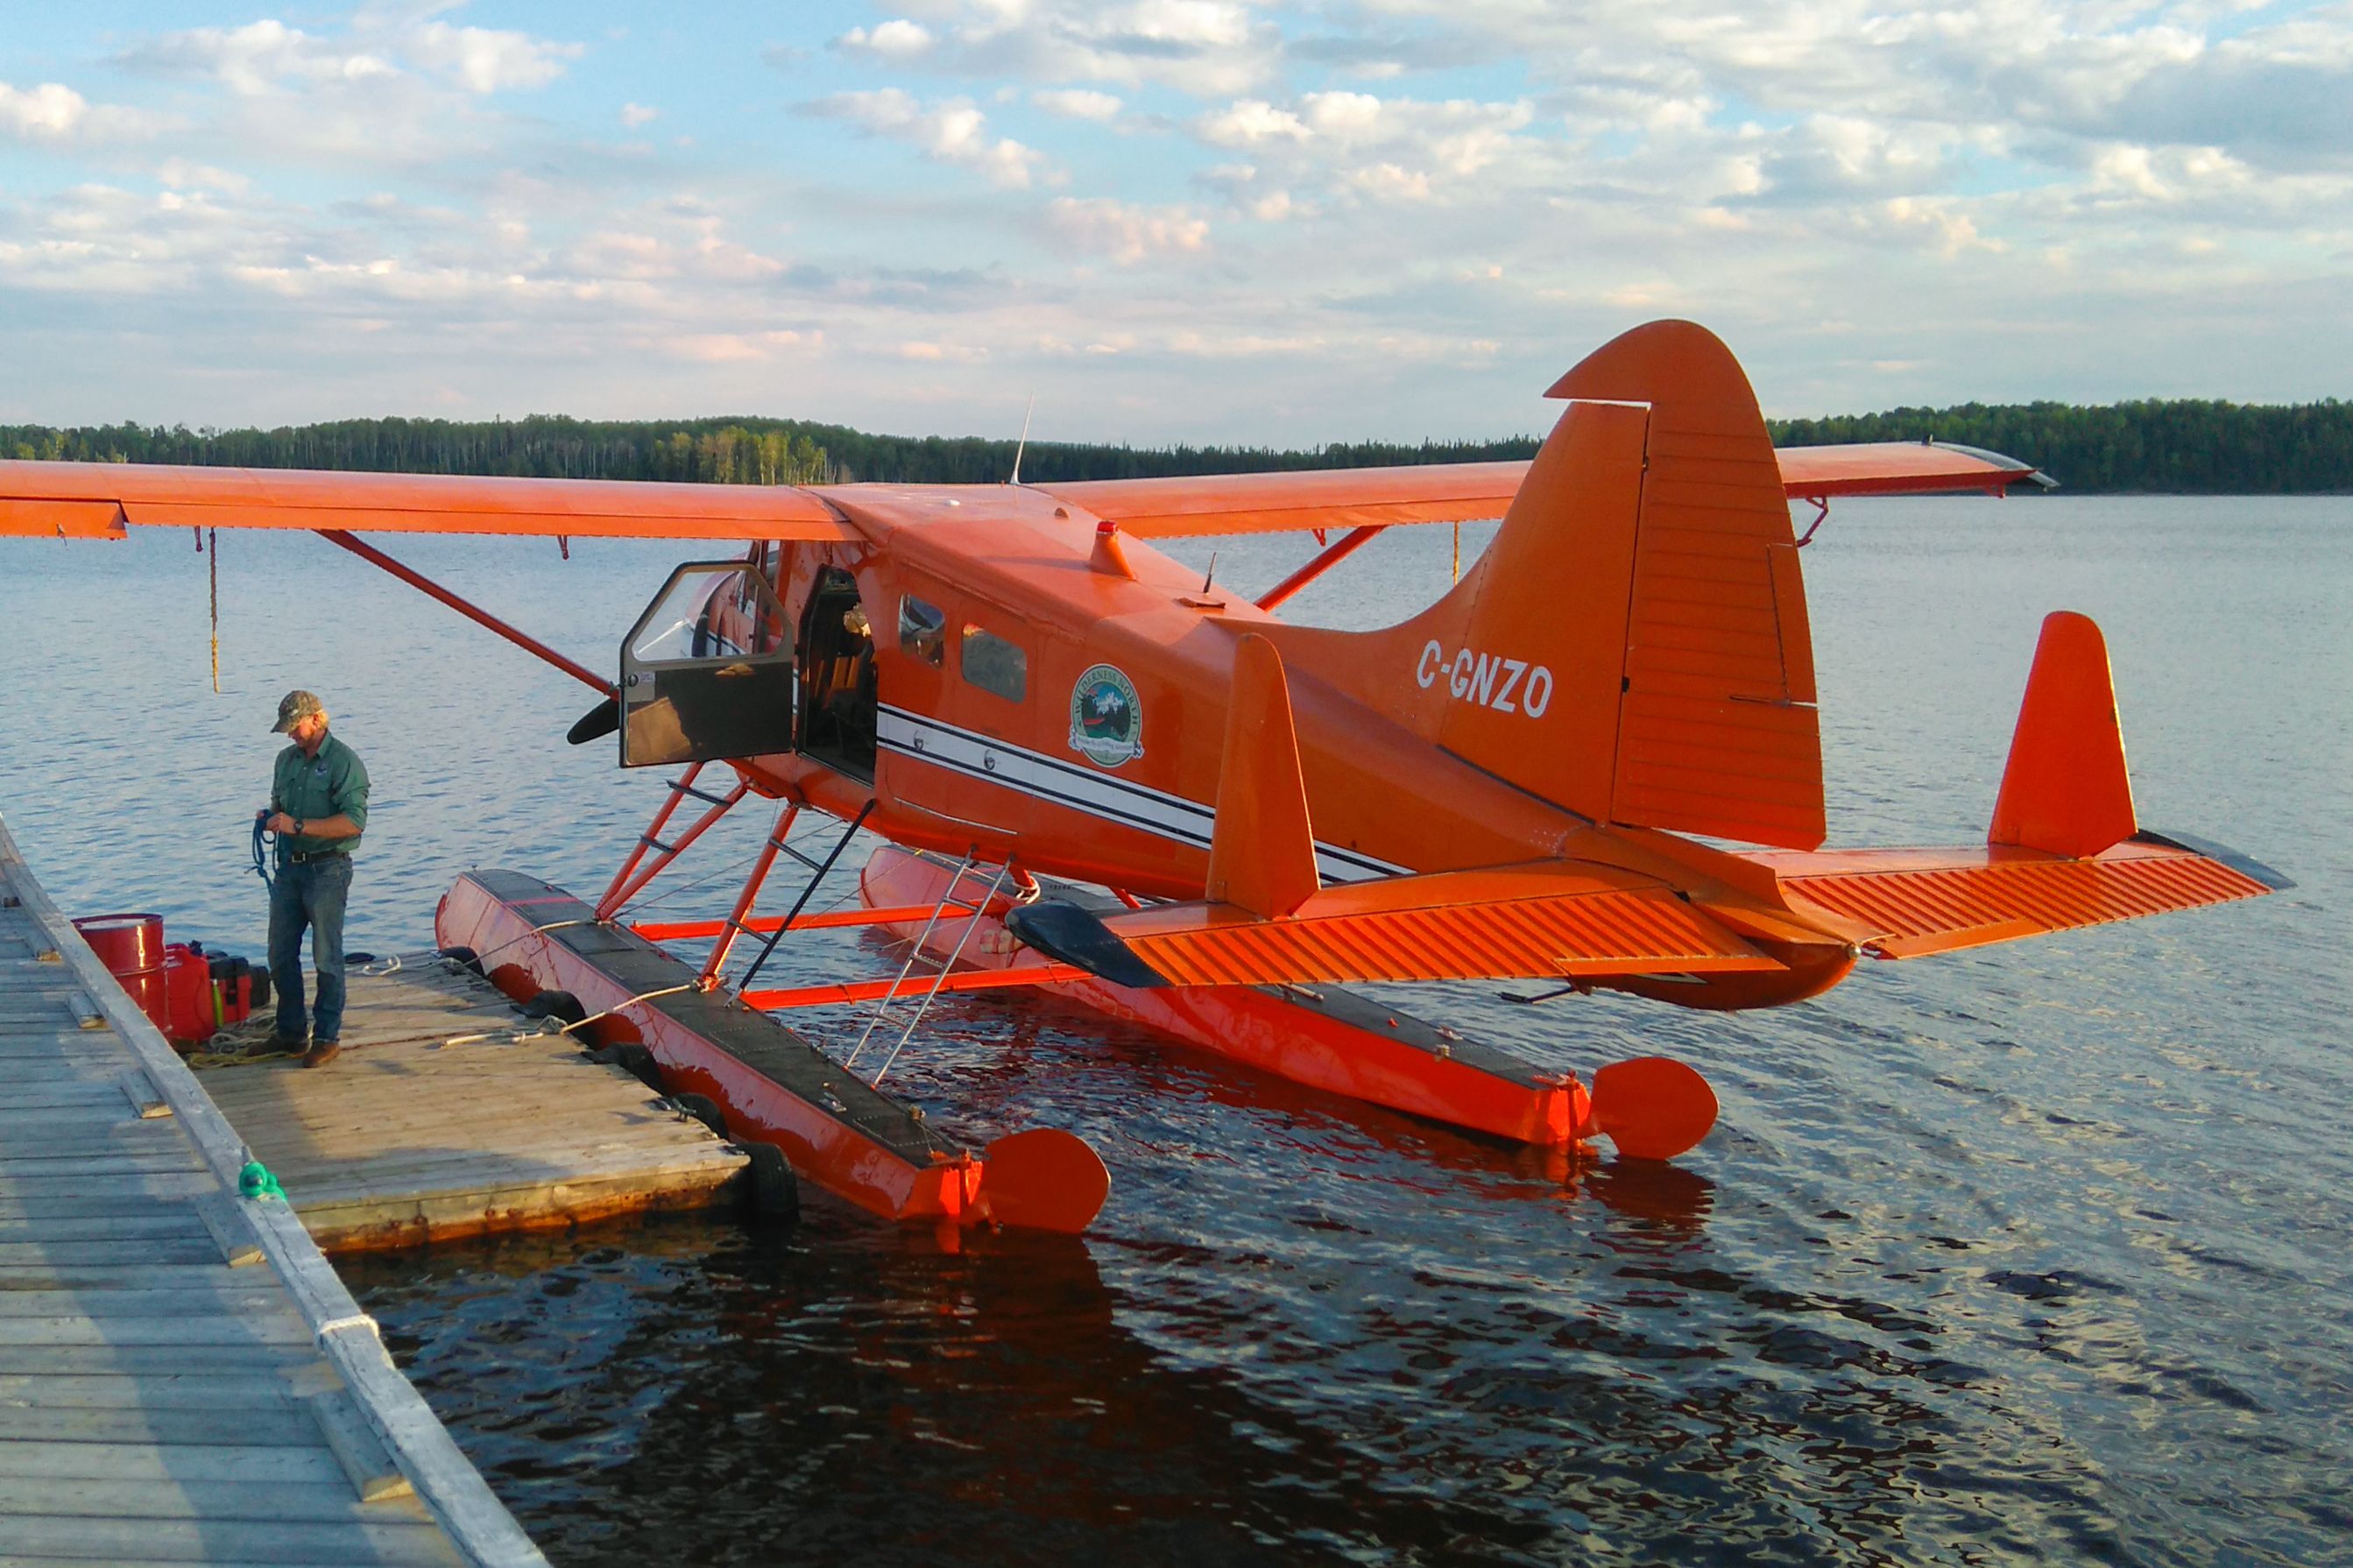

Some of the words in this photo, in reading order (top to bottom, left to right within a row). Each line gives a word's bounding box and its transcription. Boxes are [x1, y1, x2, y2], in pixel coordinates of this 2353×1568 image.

[1075, 669, 1118, 714] WILDERNESS
[1119, 676, 1138, 724] NORTH
[1417, 639, 1553, 718] C-GNZO
